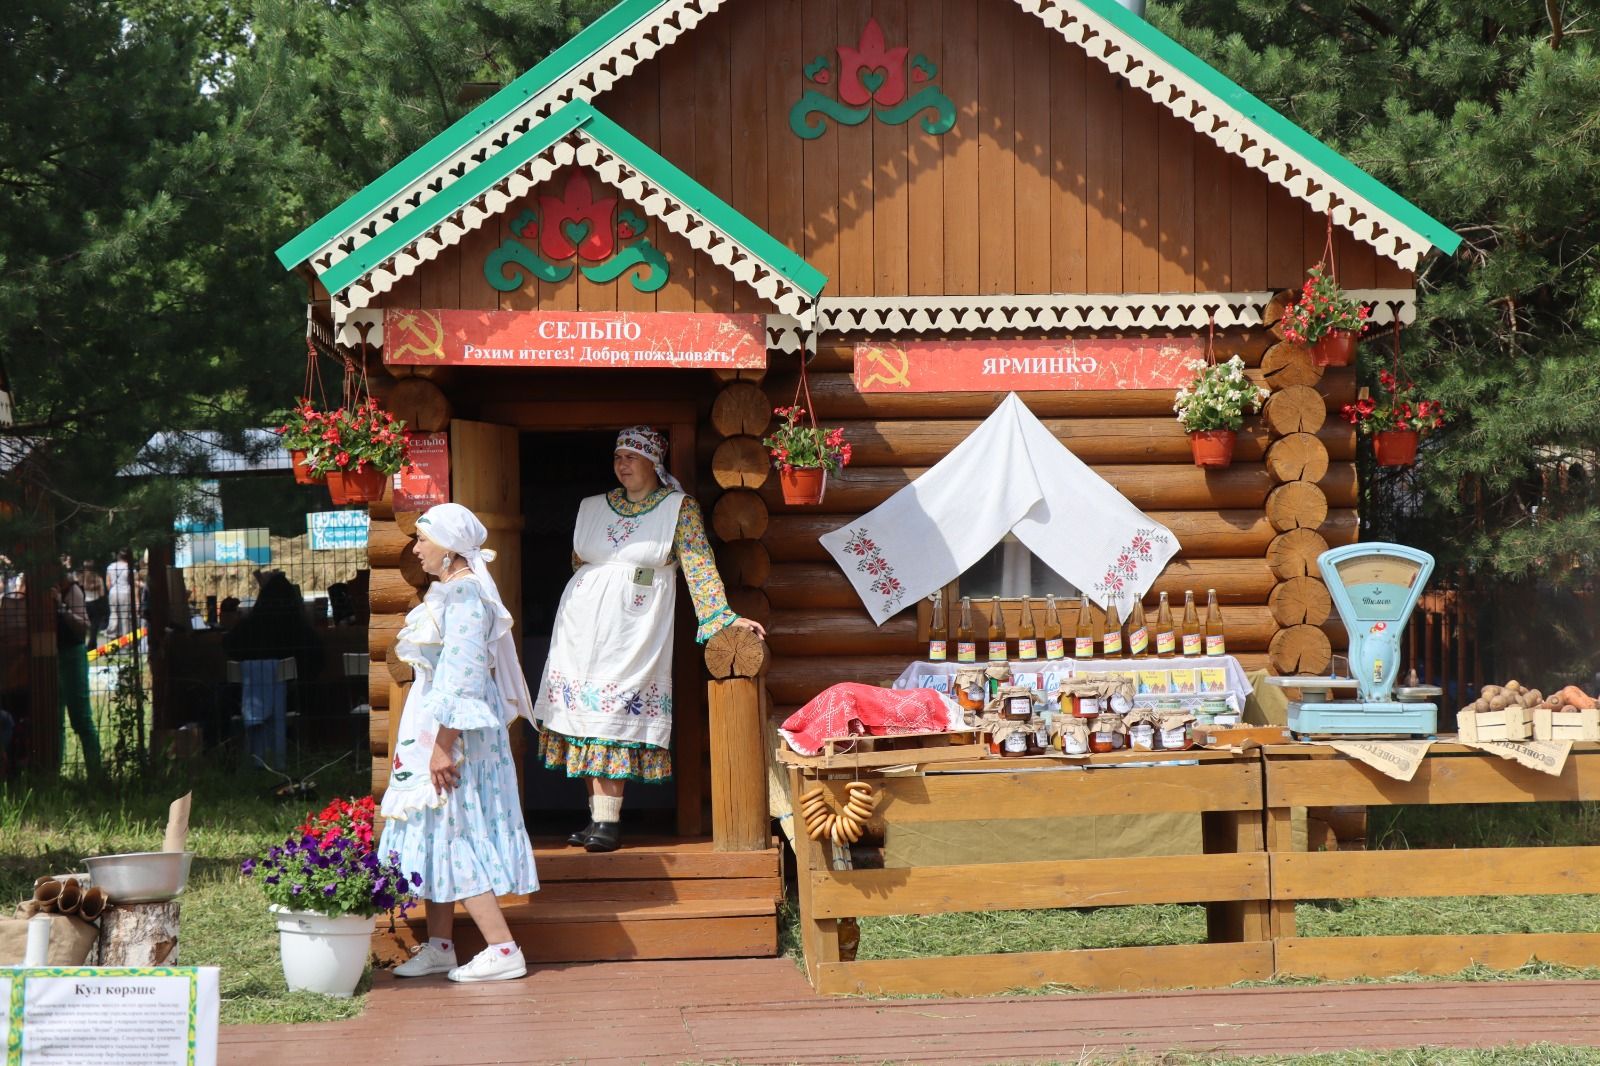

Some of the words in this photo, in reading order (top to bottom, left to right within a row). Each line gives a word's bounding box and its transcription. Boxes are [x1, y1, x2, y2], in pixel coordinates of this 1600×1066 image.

[538, 321, 642, 341] СЕЛЬПО
[463, 344, 514, 359] Рәхим
[519, 346, 576, 361] итегез!
[579, 346, 630, 364] Добро
[633, 348, 736, 363] пожаловать!
[981, 356, 1098, 375] ЯРМИНКӘ
[409, 438, 446, 447] СЕЛЬПО
[75, 984, 102, 998] Кул
